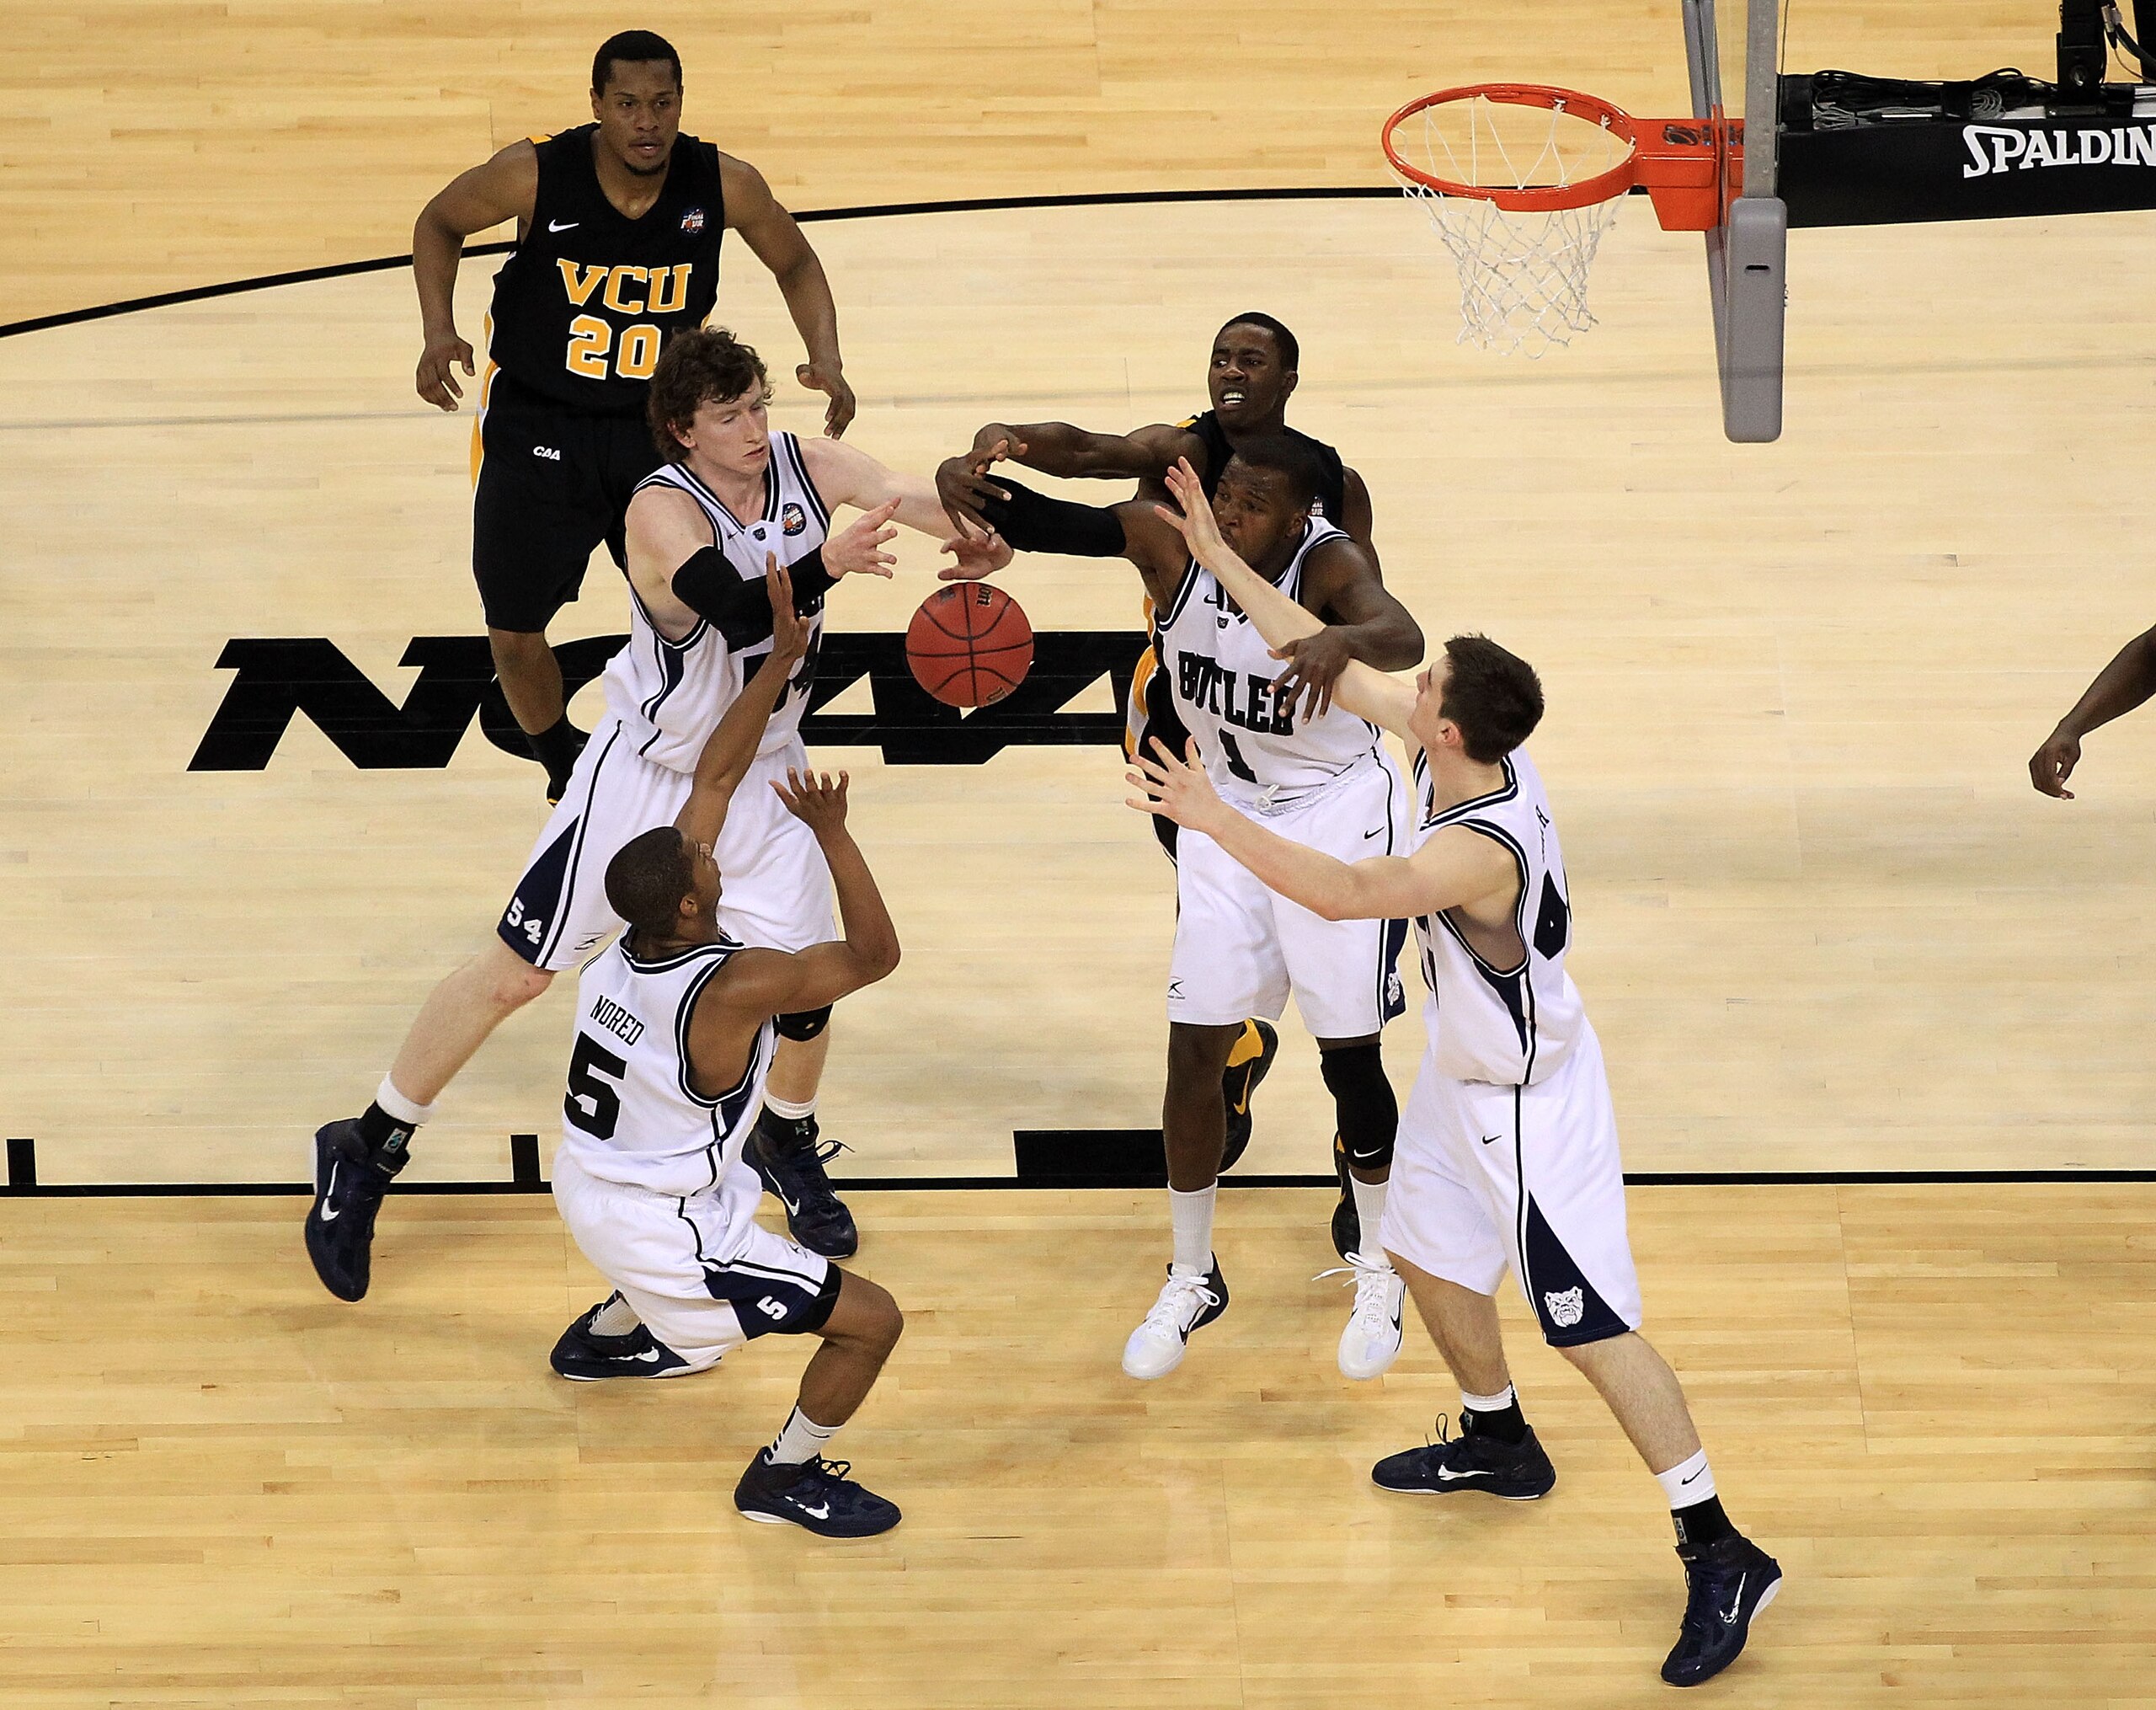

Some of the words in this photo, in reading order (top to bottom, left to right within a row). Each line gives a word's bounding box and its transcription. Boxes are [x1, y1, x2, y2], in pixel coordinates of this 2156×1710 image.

[557, 258, 693, 315] VCU
[566, 314, 662, 381] 20
[532, 446, 561, 461] CAA
[1218, 727, 1258, 784] 1
[506, 896, 543, 962] 54
[590, 994, 646, 1047] NORED
[563, 1030, 628, 1141] 5
[755, 1295, 788, 1321] 5
